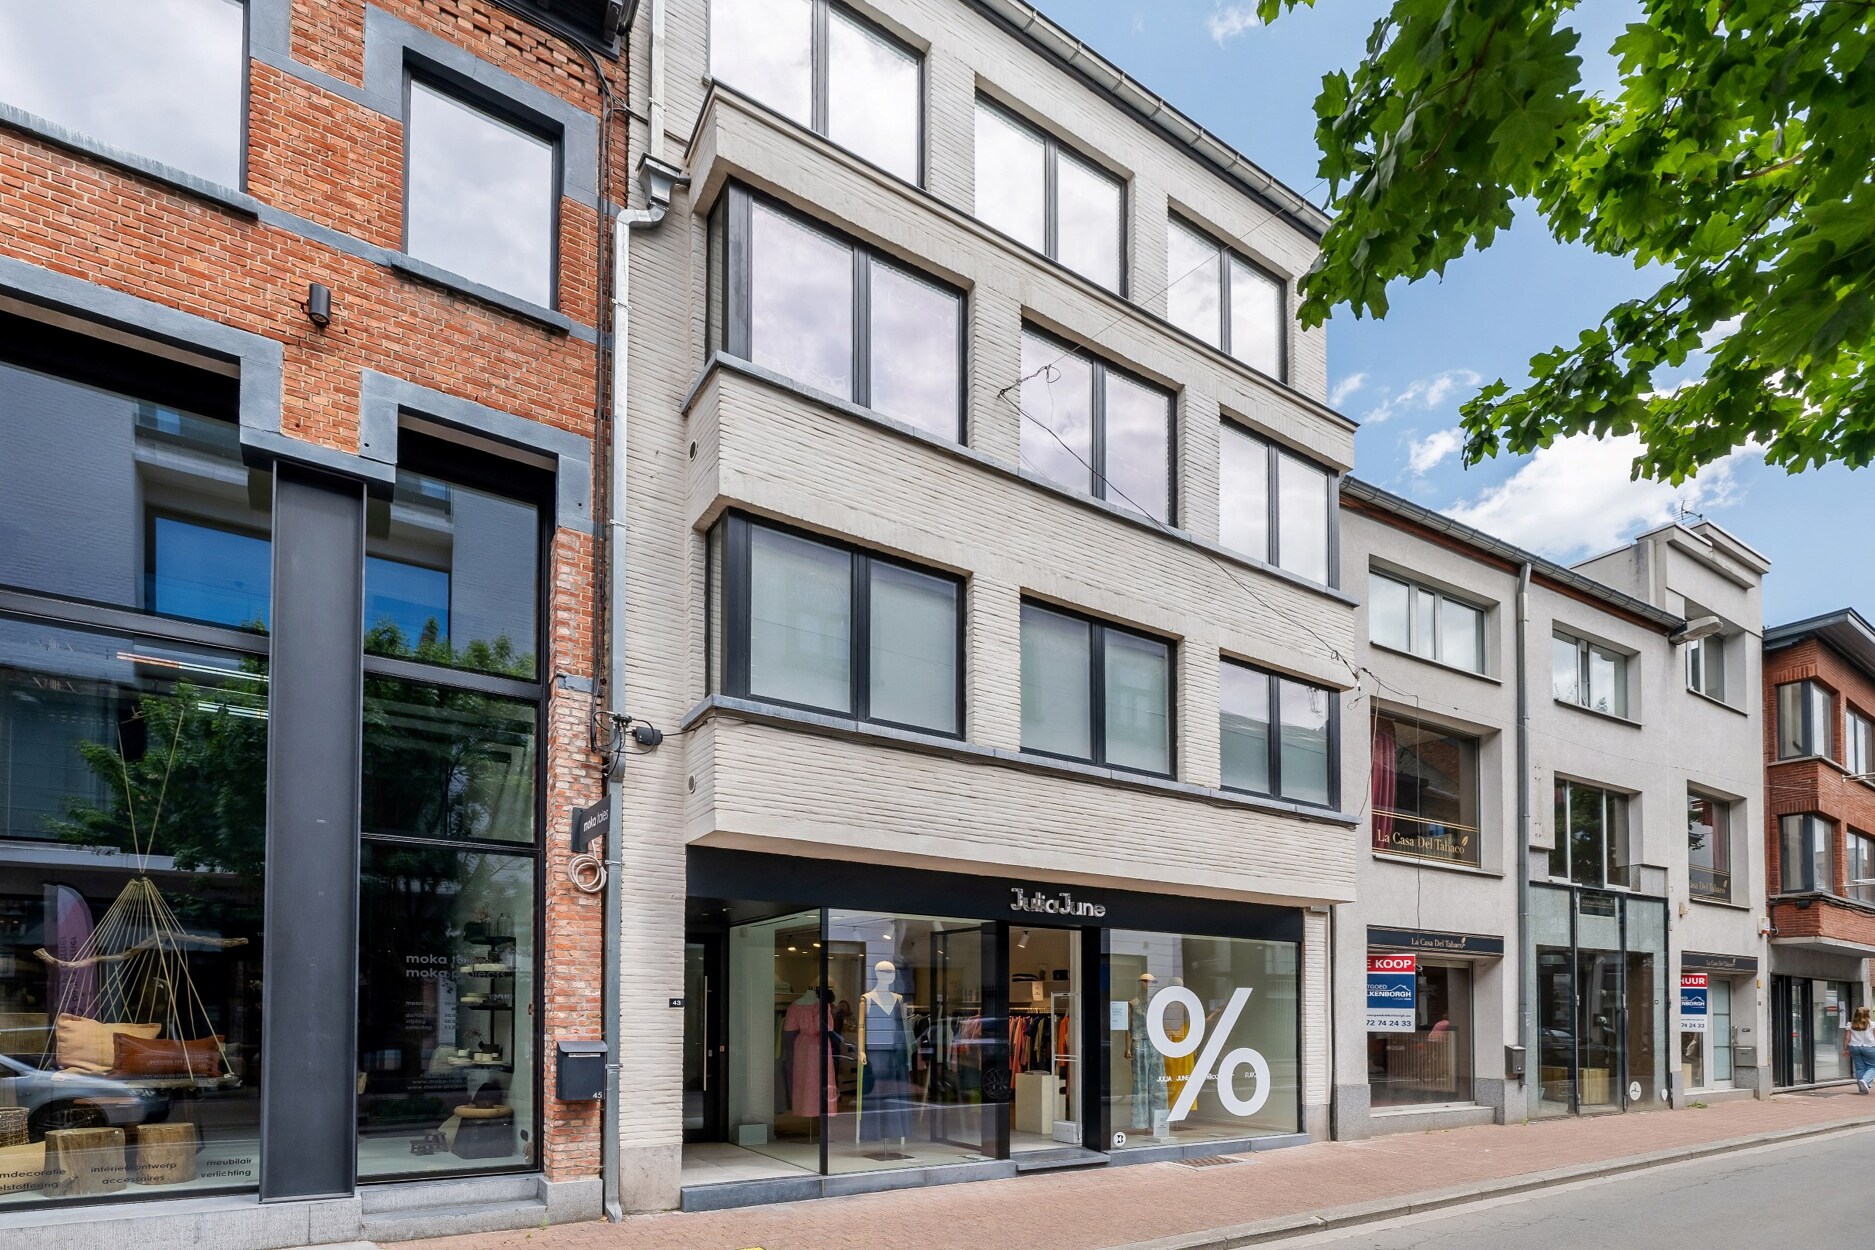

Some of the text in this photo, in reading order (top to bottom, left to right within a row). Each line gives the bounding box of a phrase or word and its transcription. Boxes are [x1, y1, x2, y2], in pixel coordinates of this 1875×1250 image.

[584, 810, 608, 832] moka tales
[1377, 829, 1465, 854] La Casa Del Tabaco
[1010, 888, 1106, 917] JuliaJune
[1420, 938, 1434, 946] Casa
[1434, 939, 1445, 947] Del
[1446, 940, 1466, 948] Tabaco
[406, 954, 448, 964] moka
[1376, 959, 1412, 969] KOOP
[406, 968, 448, 978] moka
[206, 1158, 252, 1166] meubilair
[0, 1168, 66, 1178] mdecoratie
[200, 1170, 252, 1178] verlichting
[102, 1174, 165, 1184] accessoires
